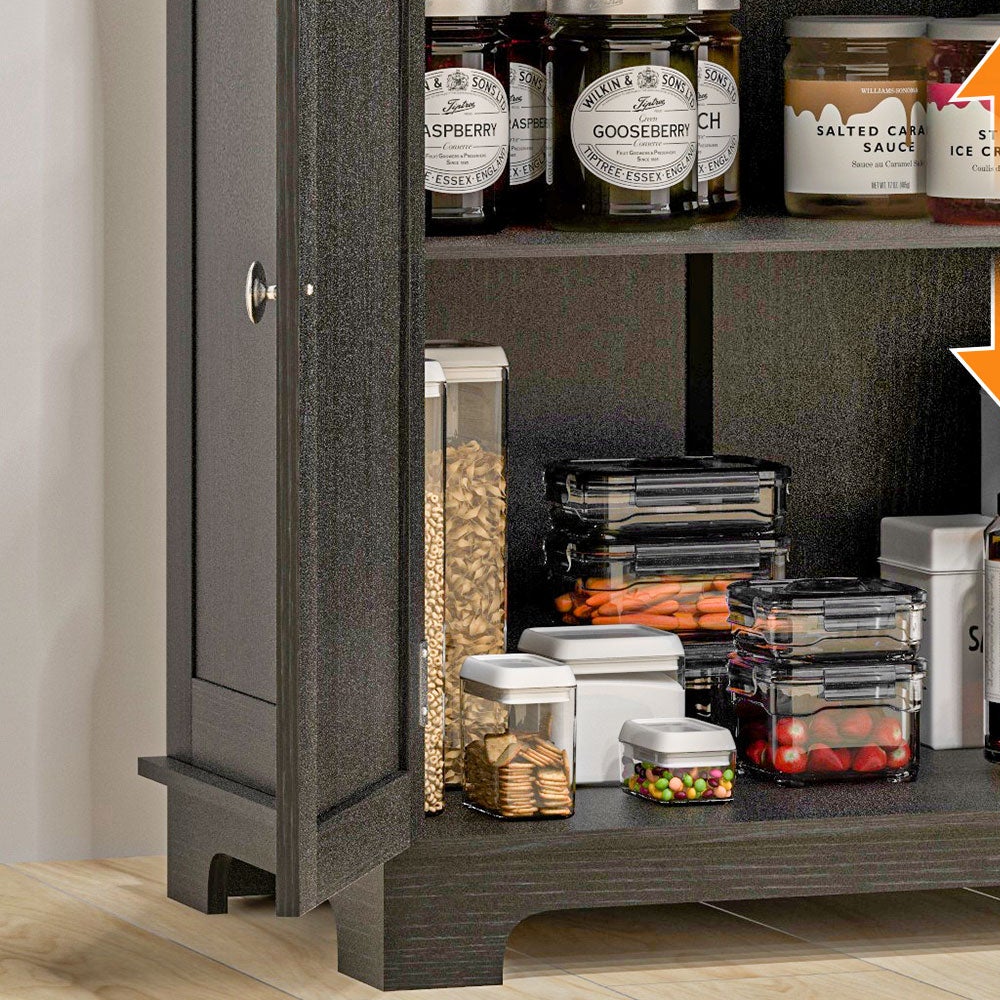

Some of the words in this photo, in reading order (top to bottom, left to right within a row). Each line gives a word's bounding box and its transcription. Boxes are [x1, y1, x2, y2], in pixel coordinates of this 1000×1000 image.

[705, 69, 727, 87] SONS
[472, 77, 496, 97] SONS
[582, 78, 620, 109] WILKIN
[662, 74, 686, 96] SONS
[425, 123, 498, 138] ASPBERRY
[593, 123, 690, 138] GOOSEBERRY
[817, 125, 879, 137] SALTED
[888, 125, 926, 136] CARA
[863, 142, 915, 153] SAUCE
[950, 146, 973, 156] ICE
